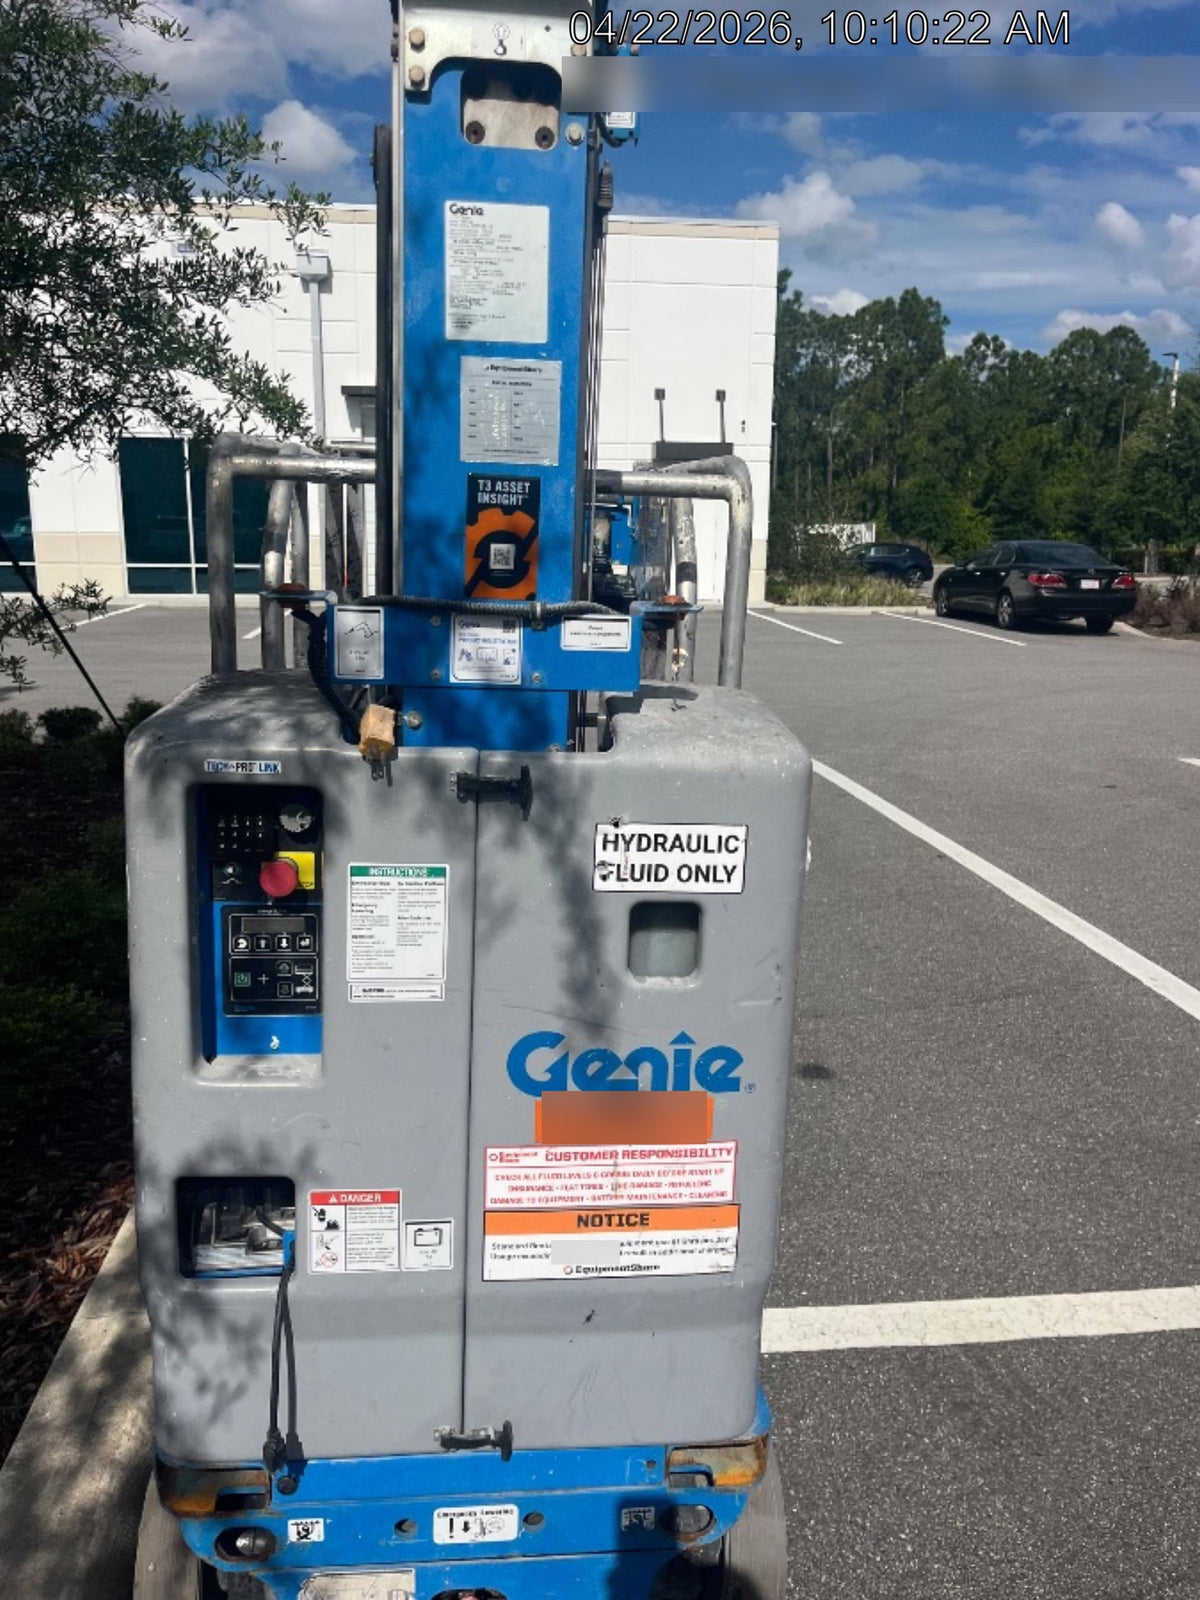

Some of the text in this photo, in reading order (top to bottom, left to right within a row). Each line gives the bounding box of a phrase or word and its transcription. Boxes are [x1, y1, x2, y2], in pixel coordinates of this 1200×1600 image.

[449, 203, 484, 216] Genie
[478, 480, 531, 494] T3 ASSET
[477, 493, 524, 506] INSIGHT
[602, 833, 740, 854] HYDRAULIC
[369, 867, 428, 878] INSTRUCTIONS
[677, 864, 737, 884] ONLY
[506, 1030, 744, 1098] Genie
[545, 1147, 733, 1161] CUSTOMER RESPONSIBILITY
[340, 1194, 382, 1203] DANGER
[577, 1213, 650, 1228] NOTICE
